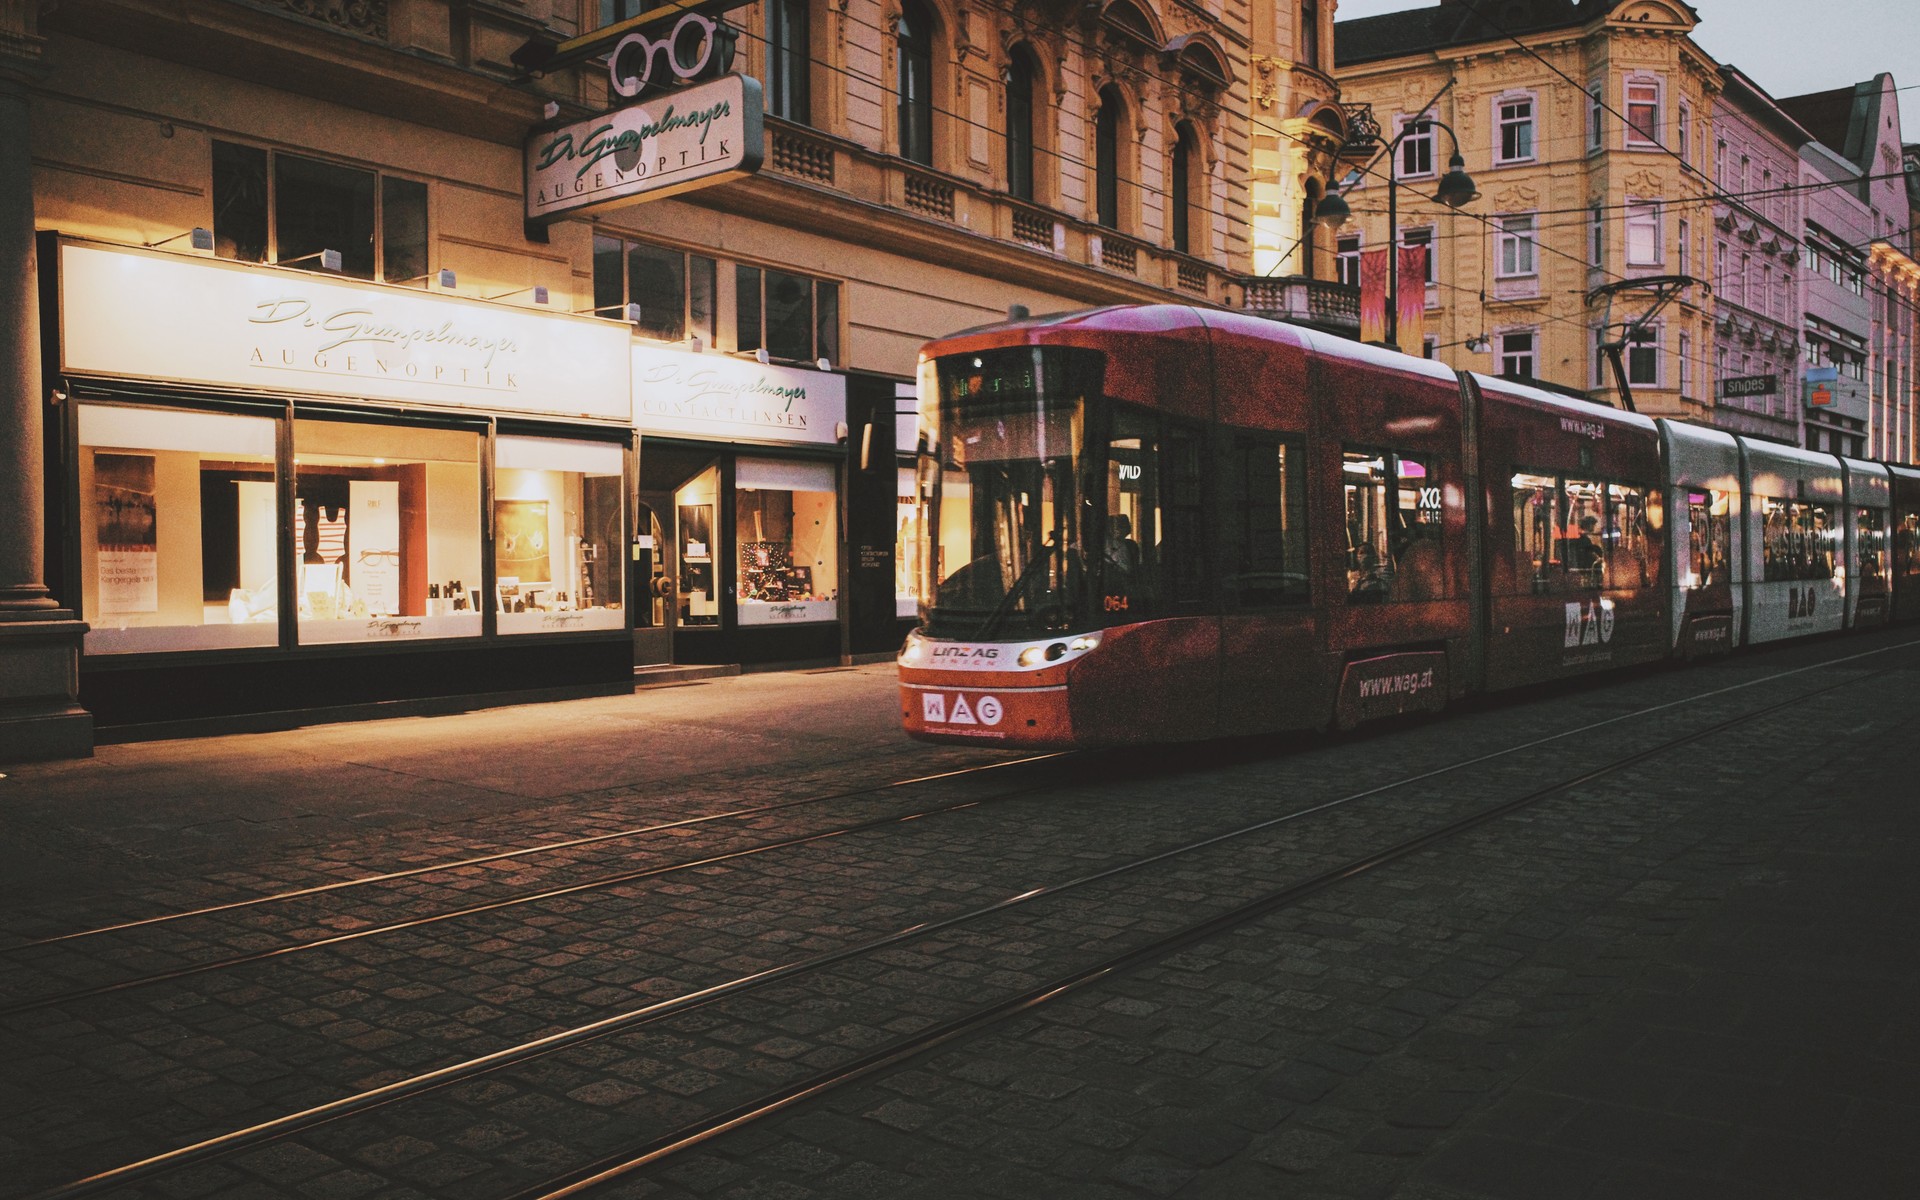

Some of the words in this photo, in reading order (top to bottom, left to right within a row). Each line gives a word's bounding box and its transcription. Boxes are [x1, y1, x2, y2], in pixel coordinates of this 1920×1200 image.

[536, 133, 579, 171] Dr.
[576, 100, 731, 178] Gumpelmayer
[537, 140, 730, 204] AUGENOPTIK
[248, 295, 320, 328] Dr.
[317, 307, 517, 369] Gumpelmayer
[250, 347, 518, 388] AUGENOPTIK
[684, 370, 807, 413] Gumpelmayer
[1727, 378, 1765, 394] snipes
[643, 399, 808, 427] CONTACTLINSEN
[1560, 417, 1605, 440] www.wag.at
[1118, 464, 1141, 480] WILD
[1103, 595, 1129, 611] 064
[1566, 603, 1613, 643] WAG
[932, 646, 970, 657] LINZ
[971, 647, 999, 659] AG
[1359, 666, 1434, 698] www.wag.at
[925, 697, 1001, 722] WAG
